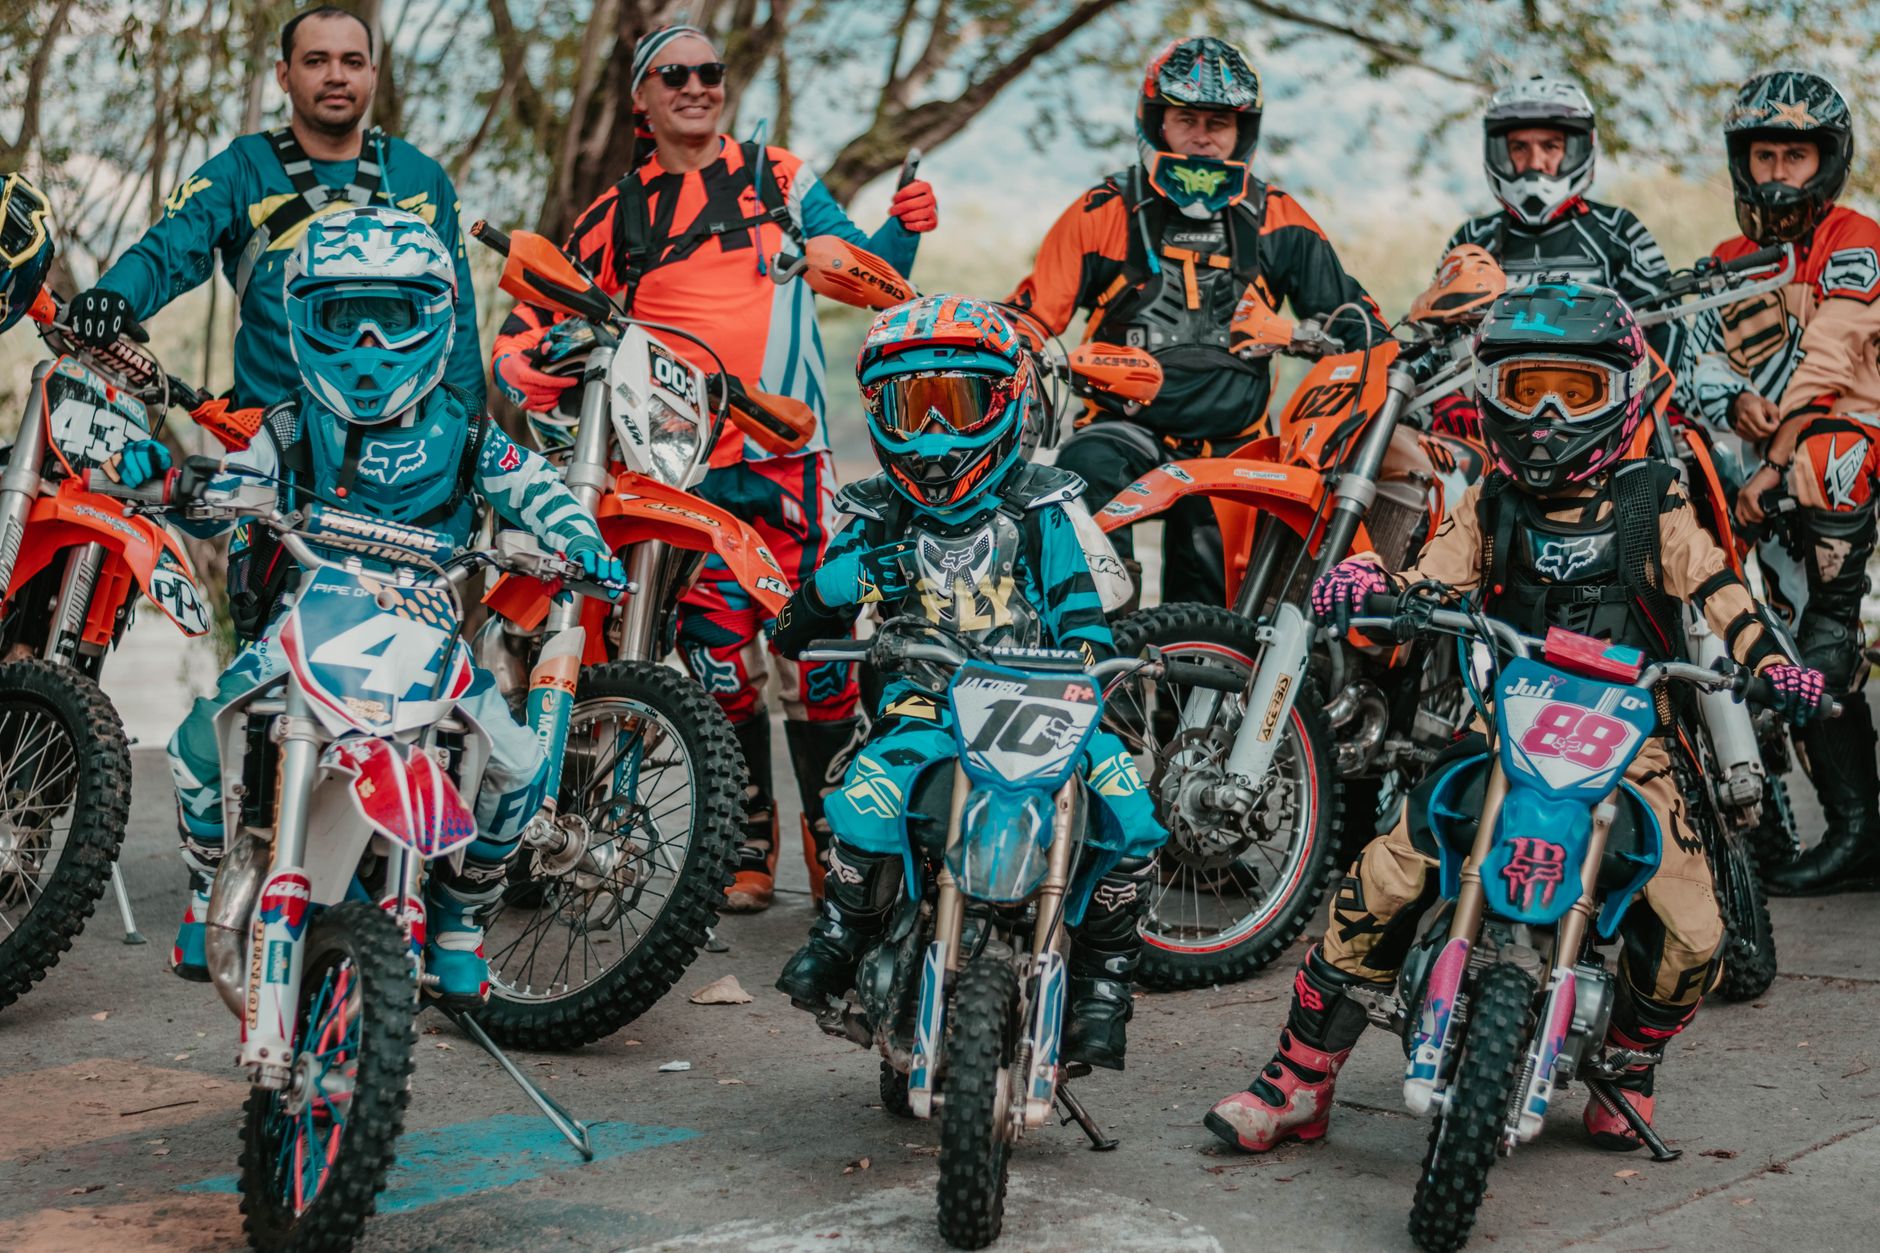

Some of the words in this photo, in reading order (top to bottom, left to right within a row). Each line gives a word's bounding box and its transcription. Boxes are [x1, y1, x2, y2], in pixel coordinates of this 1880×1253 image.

[848, 267, 906, 301] ACERBIS
[655, 357, 697, 405] 003
[1091, 357, 1150, 368] ACERBIS
[1290, 382, 1368, 424] 027
[319, 512, 438, 553] RENTHAL
[309, 612, 449, 699] 4
[961, 677, 1028, 695] JACOBO
[1504, 675, 1555, 699] Juli
[966, 700, 1073, 757] 10
[1262, 677, 1289, 741] ACERBIS
[1518, 702, 1631, 771] 88
[266, 881, 311, 899] KTM
[248, 921, 265, 1031] DUNLOP
